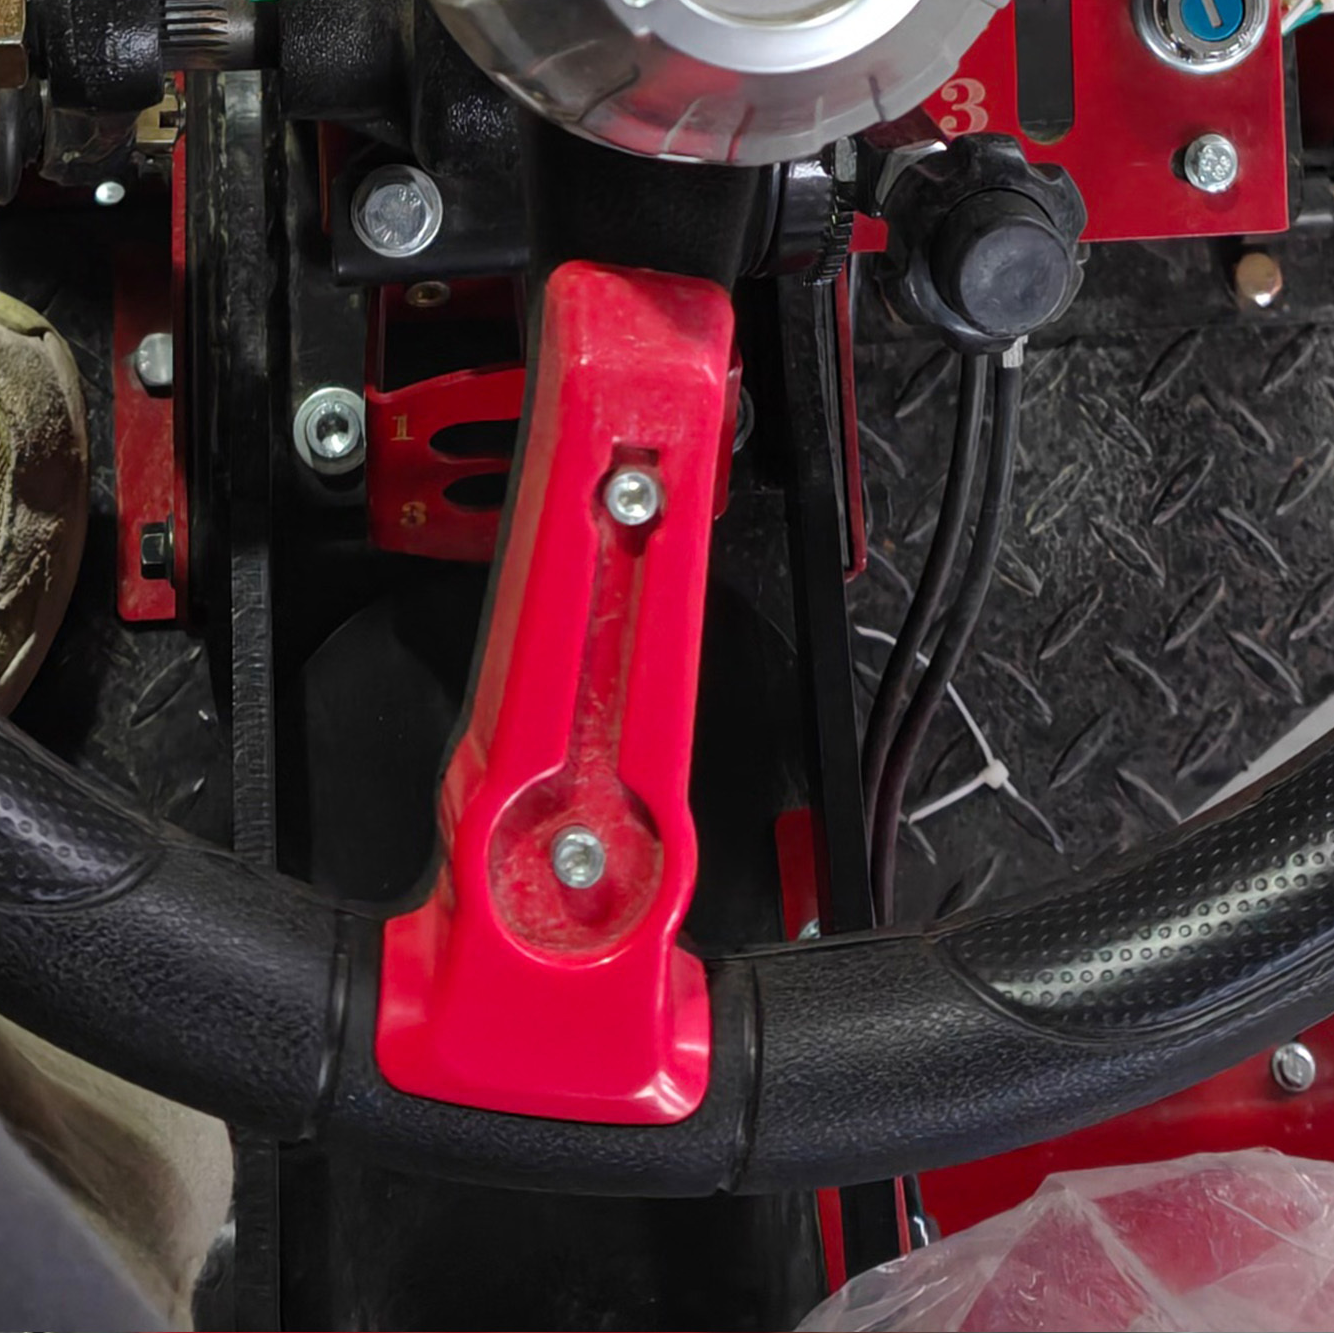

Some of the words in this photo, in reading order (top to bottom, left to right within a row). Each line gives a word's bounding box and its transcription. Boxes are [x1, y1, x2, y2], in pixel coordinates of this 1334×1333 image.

[940, 77, 989, 135] 3
[390, 414, 415, 441] 1
[399, 500, 427, 528] 3
